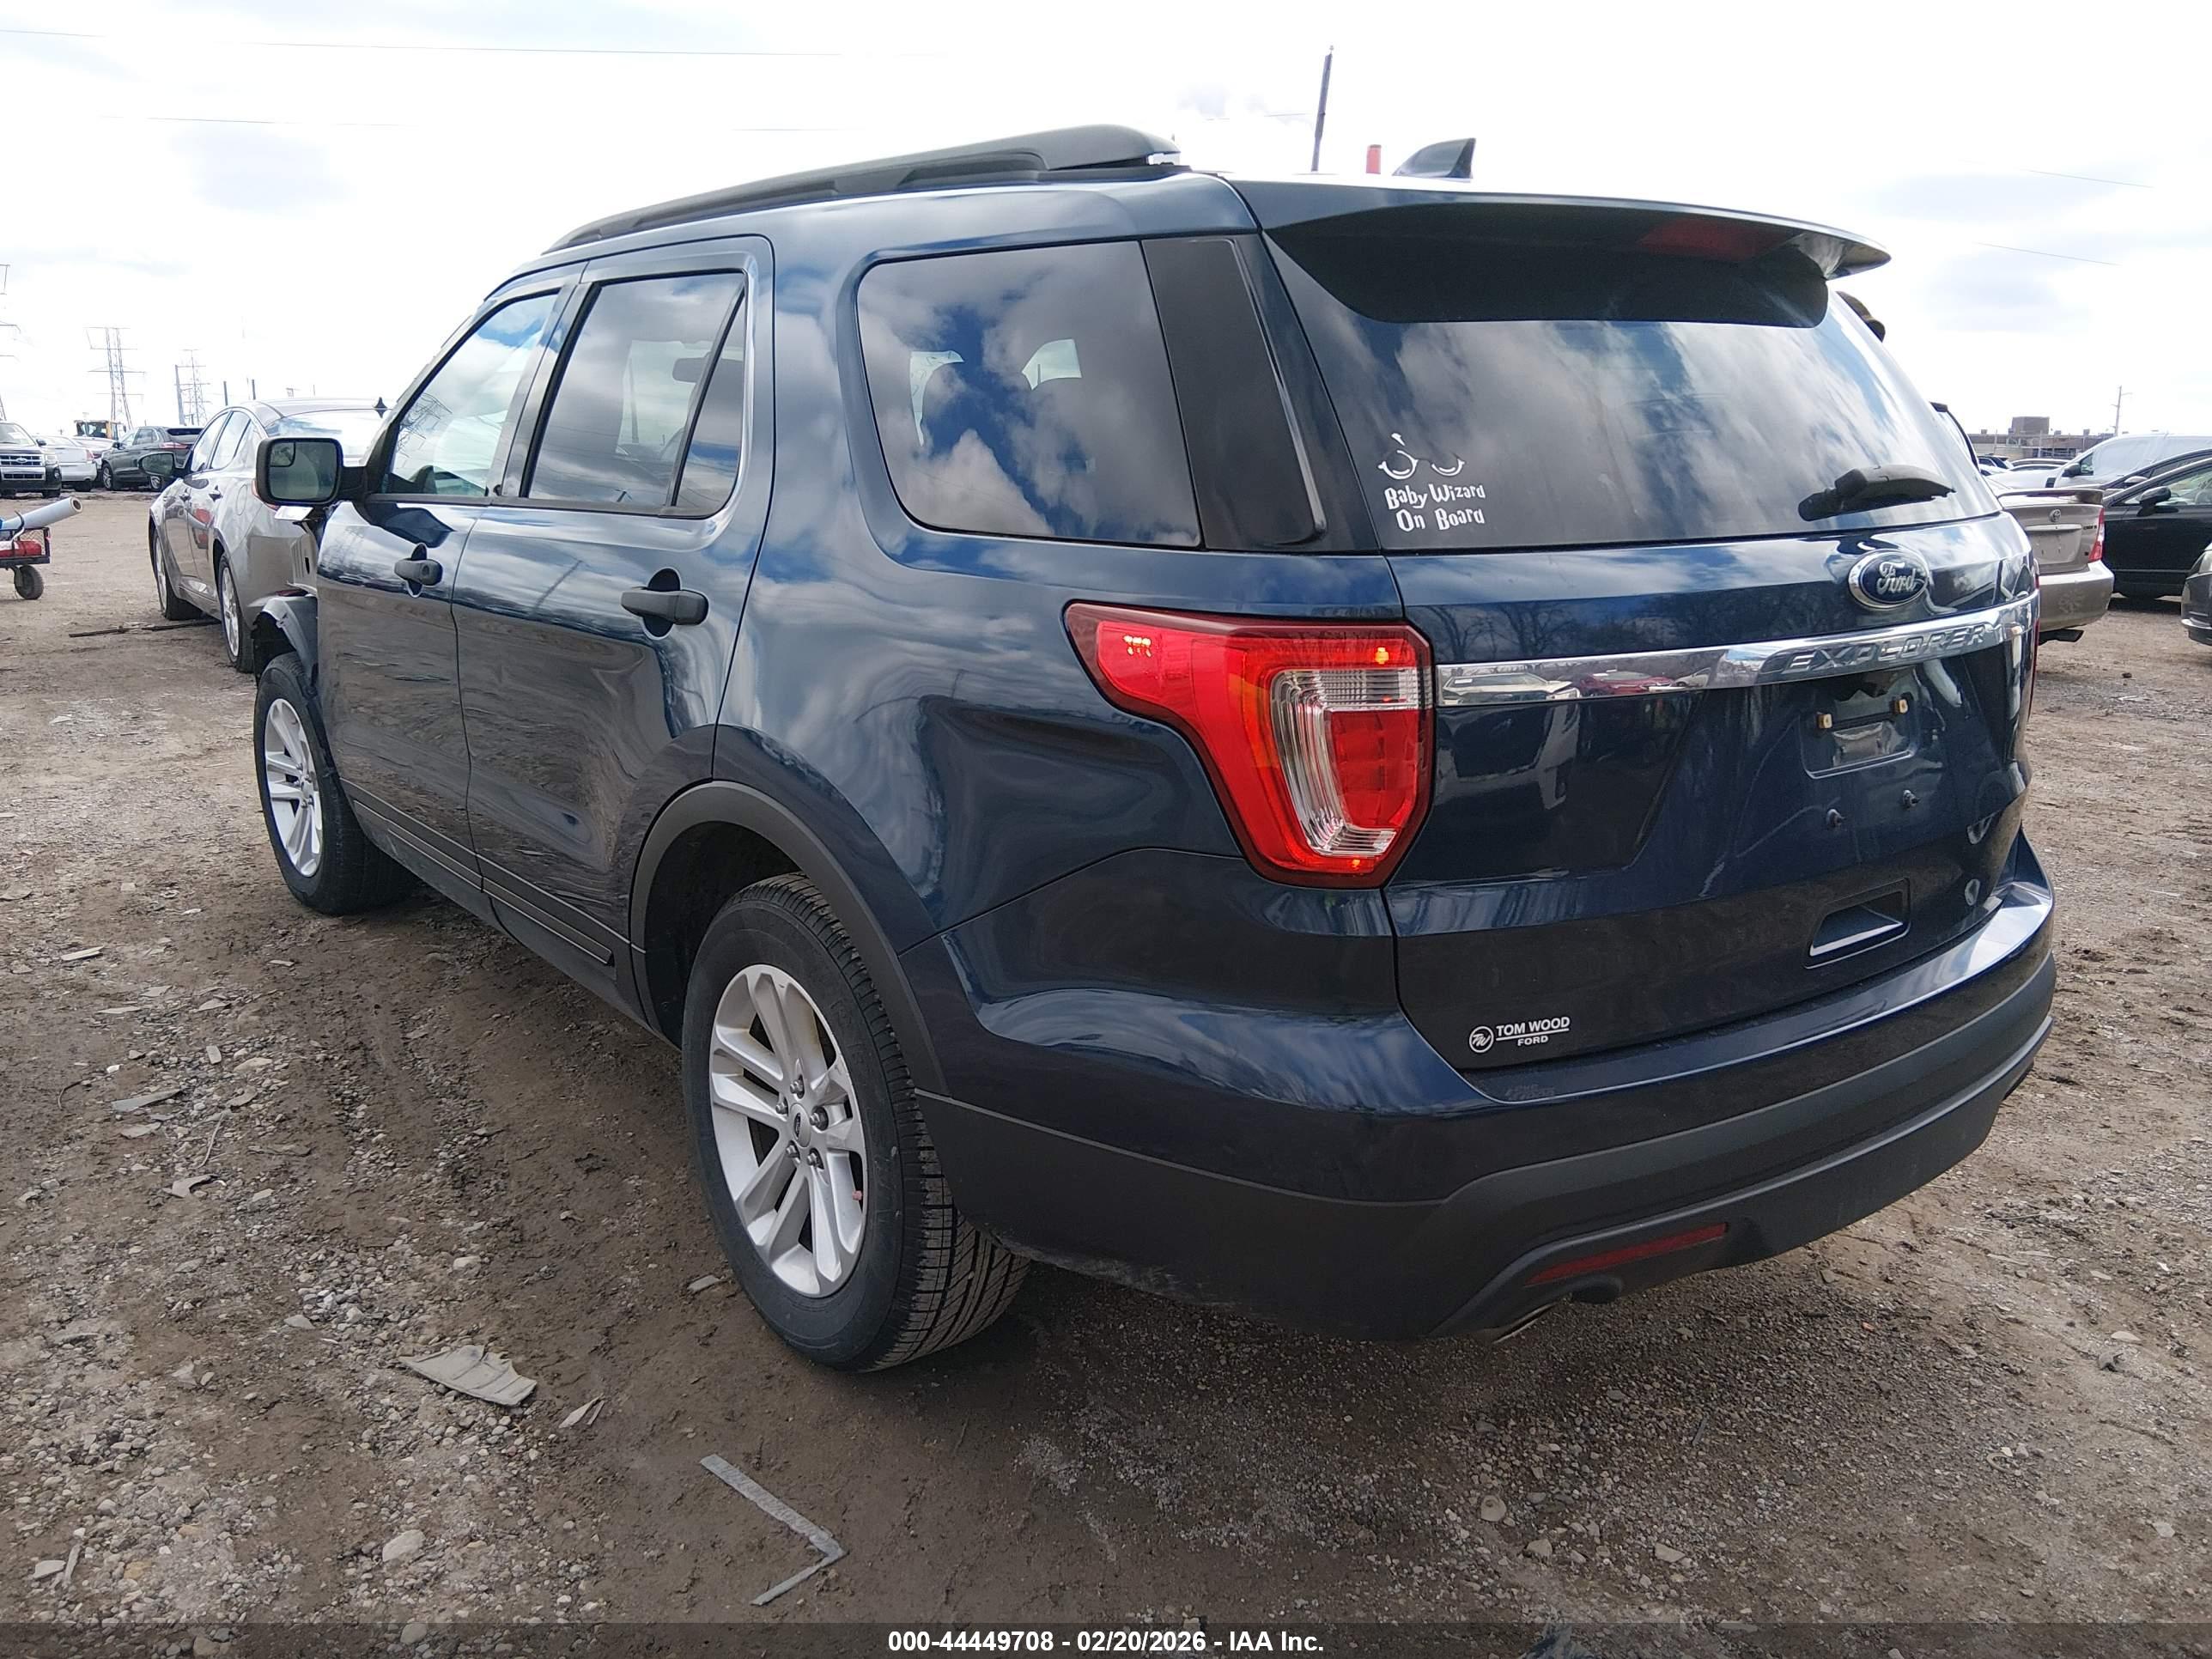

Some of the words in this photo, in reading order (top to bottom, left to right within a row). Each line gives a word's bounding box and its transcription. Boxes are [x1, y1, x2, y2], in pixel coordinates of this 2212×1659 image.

[1384, 485, 1428, 509] Baby
[1428, 483, 1486, 502] Wizard
[1396, 509, 1425, 532] On
[1434, 507, 1485, 530] Board
[1876, 561, 1924, 594] Ford
[1783, 623, 1986, 674] EXPLORER
[1496, 1023, 1525, 1036] TOM
[1528, 1016, 1571, 1032] WOOD
[1517, 1036, 1549, 1047] FORD
